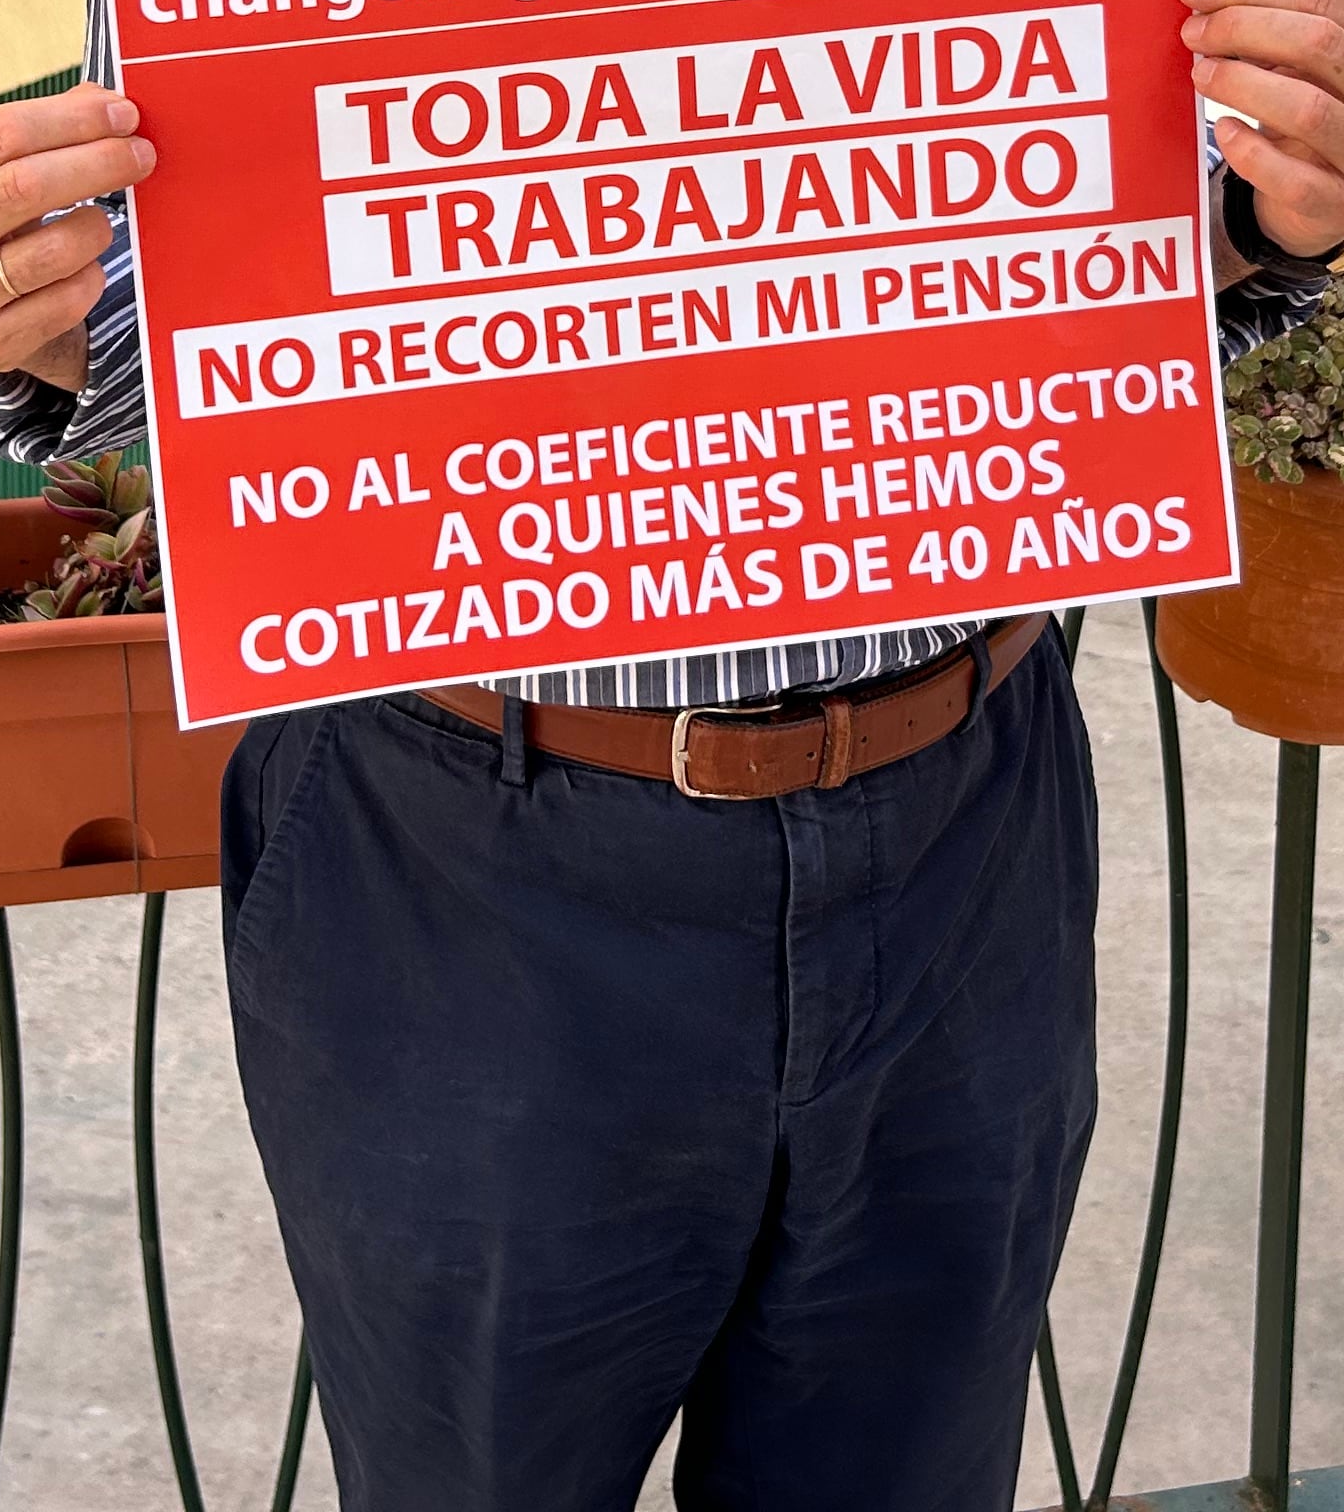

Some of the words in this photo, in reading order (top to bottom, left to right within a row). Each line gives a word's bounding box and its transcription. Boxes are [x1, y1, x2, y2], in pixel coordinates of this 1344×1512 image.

[345, 63, 647, 164] TODA
[677, 47, 804, 132] LA
[824, 19, 1077, 114] VIDA
[366, 130, 1077, 277] TRABAJANDO
[199, 338, 315, 407] NO
[339, 286, 732, 389] RECORTEN
[757, 273, 840, 338] MI
[863, 232, 1178, 325] PENSIÓN
[230, 467, 329, 527] NO
[349, 453, 430, 510] AL
[446, 400, 853, 494] COEFICIENTE
[869, 360, 1198, 445] REDUCTOR
[434, 512, 482, 570] A
[499, 472, 803, 564] QUIENES
[822, 440, 1065, 521] HEMOS
[241, 572, 609, 673] COTIZADO
[631, 543, 782, 621] MÁS
[801, 536, 892, 599] DE
[909, 526, 987, 583] 40
[1007, 497, 1190, 573] AÑOS
